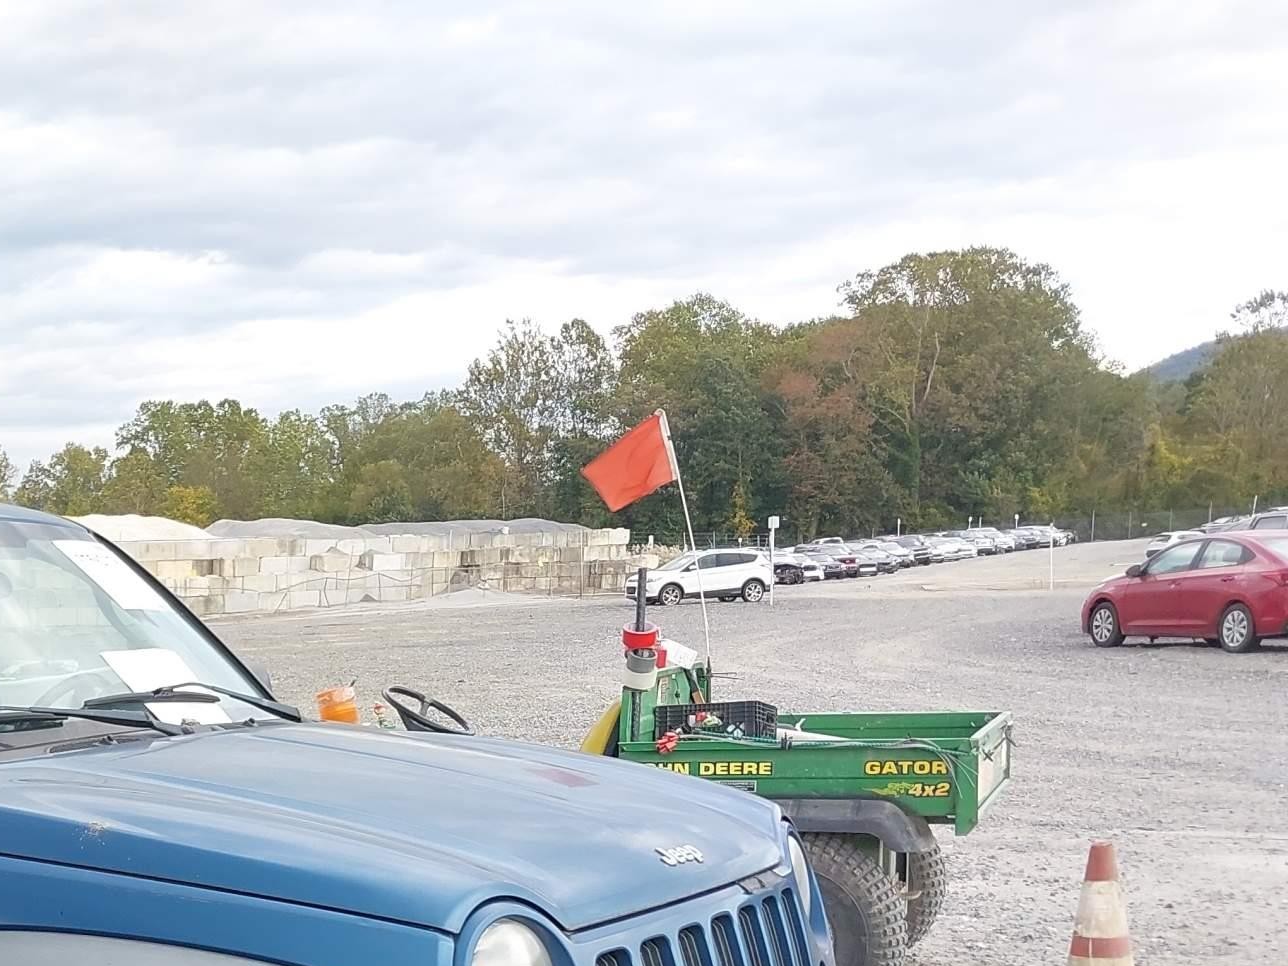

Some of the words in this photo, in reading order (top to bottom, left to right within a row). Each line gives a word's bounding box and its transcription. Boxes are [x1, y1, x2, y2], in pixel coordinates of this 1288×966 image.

[698, 761, 772, 776] DEERE
[864, 760, 948, 776] GATOR
[907, 782, 950, 797] 4x2
[655, 844, 704, 866] Jeep
